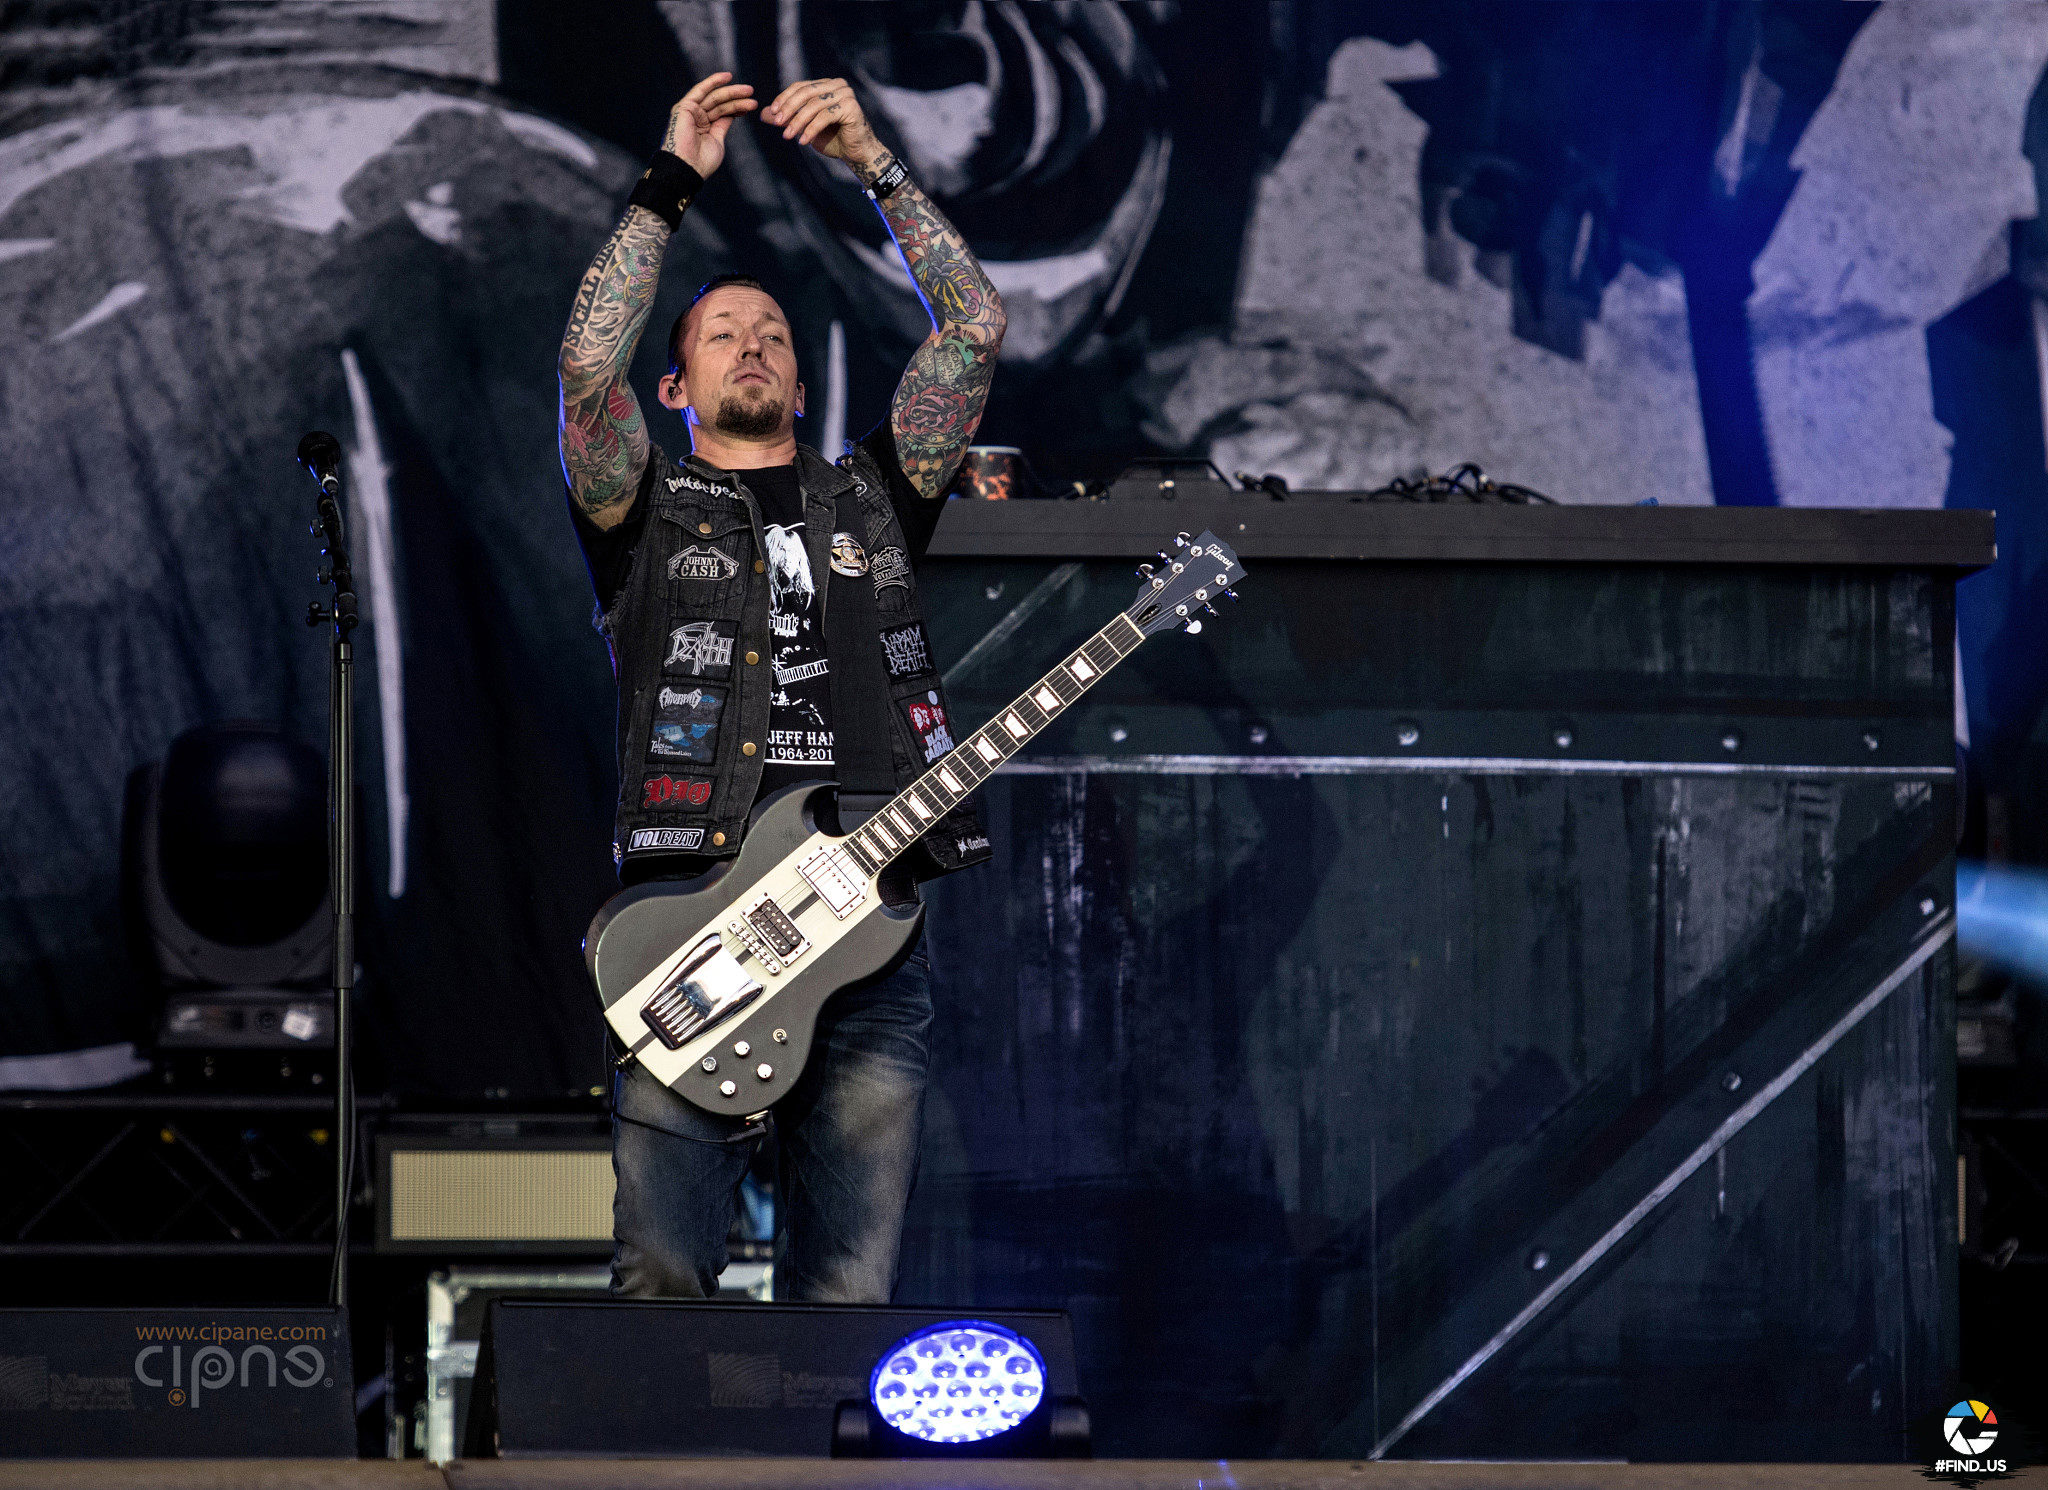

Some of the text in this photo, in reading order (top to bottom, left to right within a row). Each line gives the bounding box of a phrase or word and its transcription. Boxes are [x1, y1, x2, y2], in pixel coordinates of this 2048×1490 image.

[564, 276, 602, 348] SOCIAL
[683, 556, 719, 566] JOHNNY
[1204, 543, 1235, 572] Gibson
[680, 565, 720, 578] CASH
[767, 730, 803, 745] JEFF
[633, 830, 699, 847] VOLBEAT
